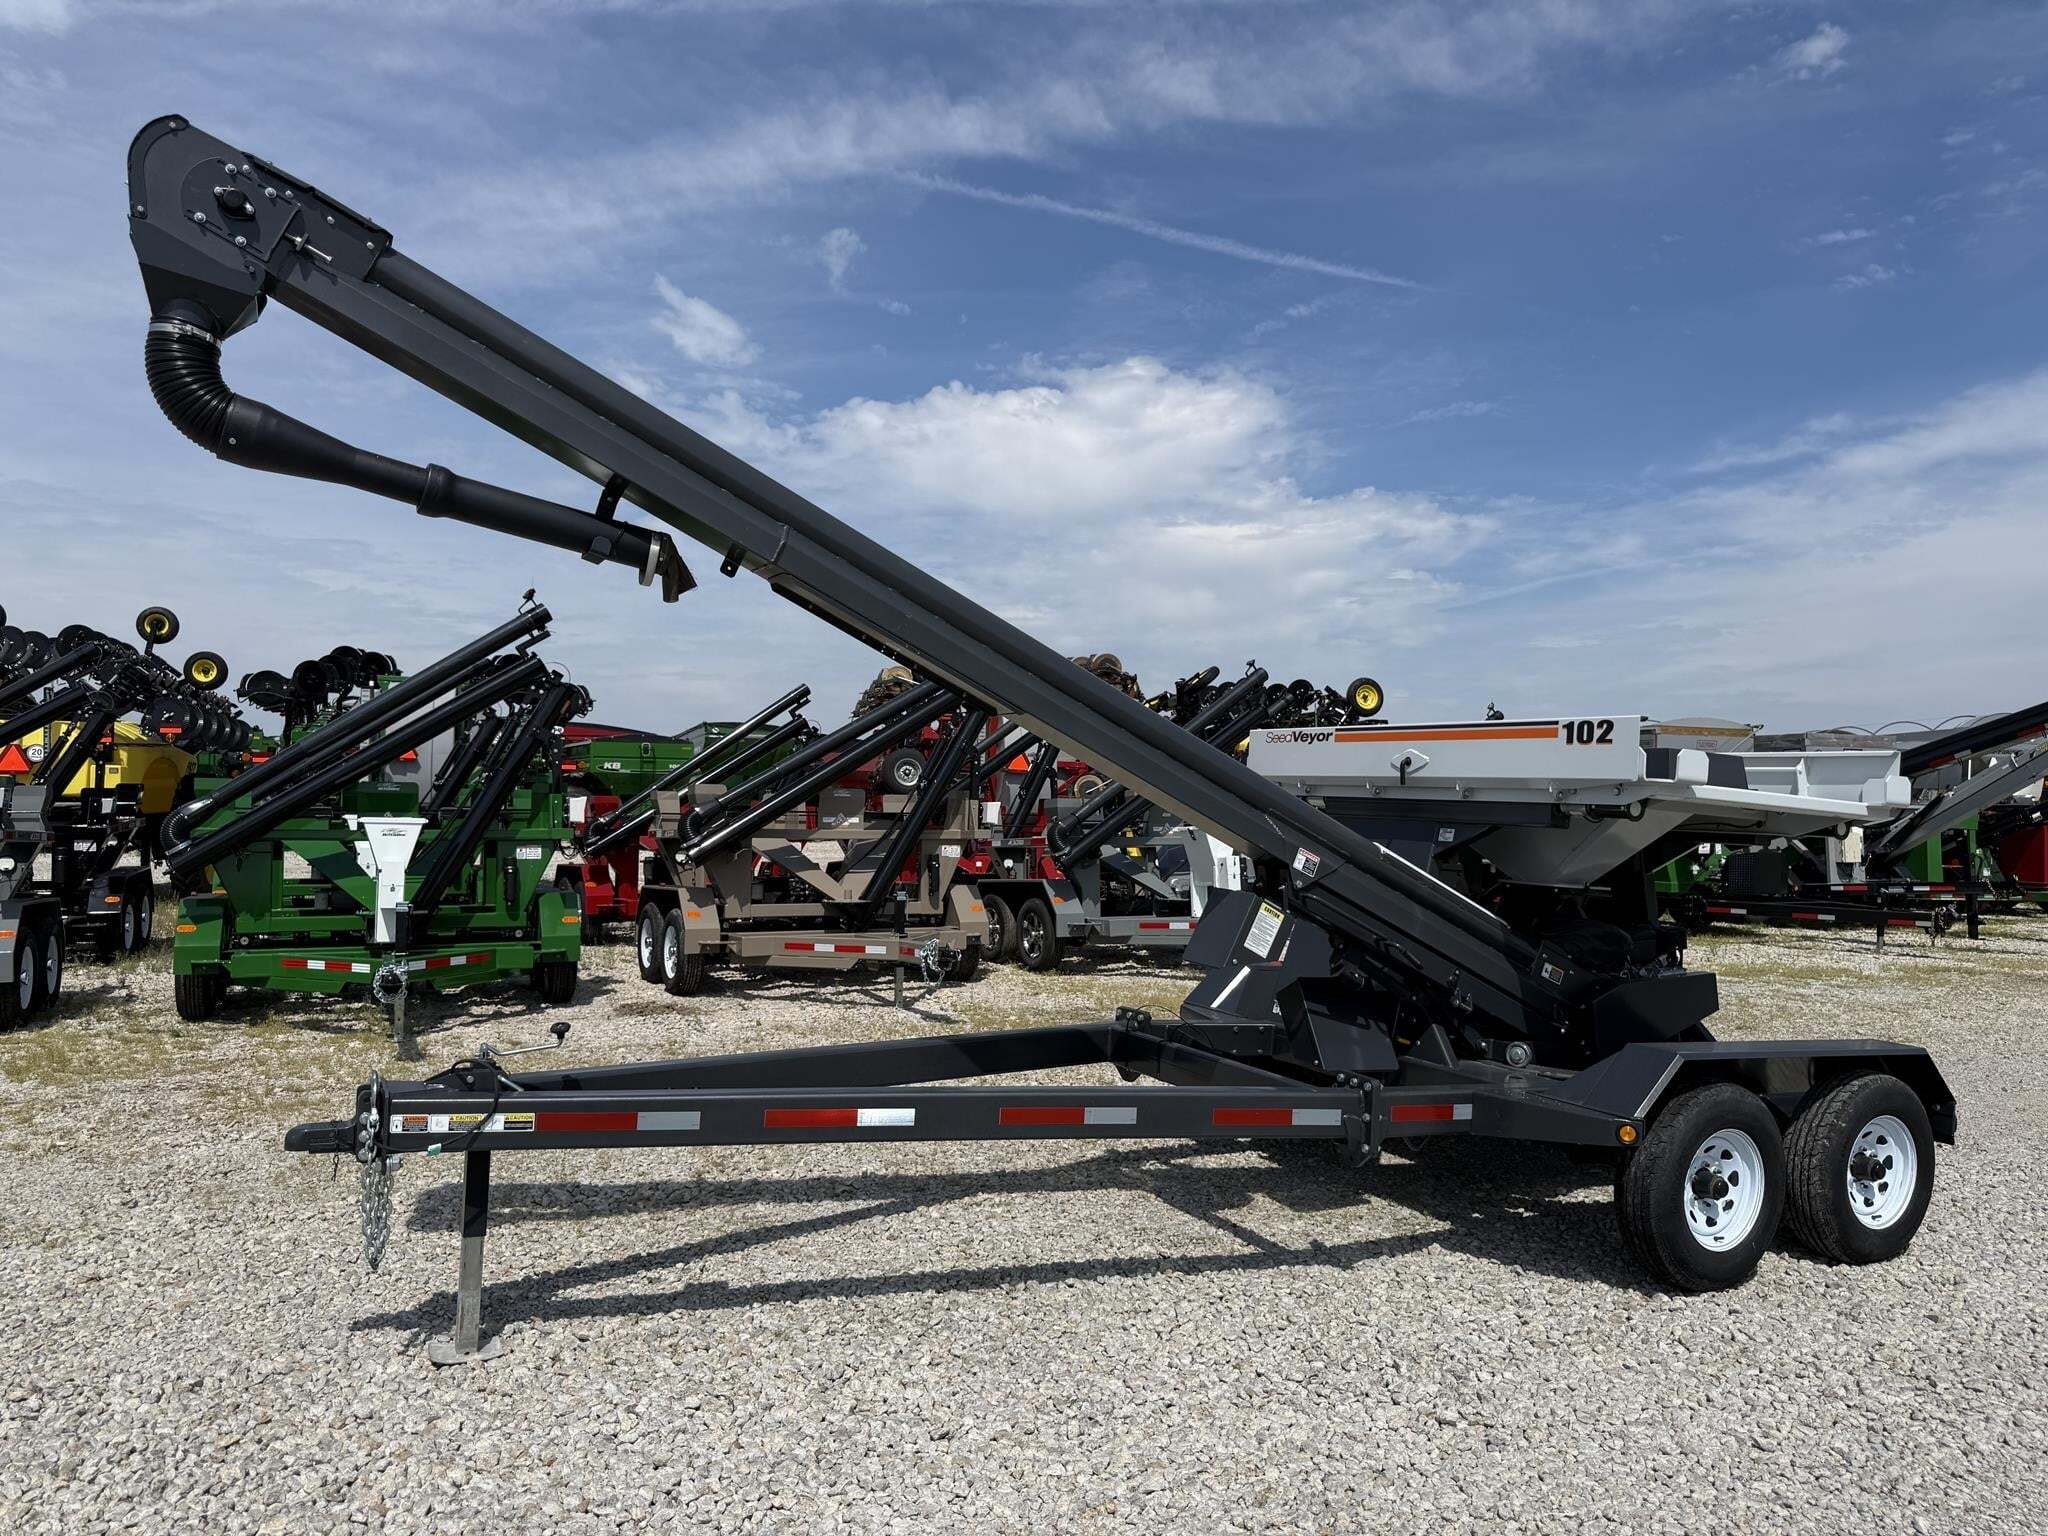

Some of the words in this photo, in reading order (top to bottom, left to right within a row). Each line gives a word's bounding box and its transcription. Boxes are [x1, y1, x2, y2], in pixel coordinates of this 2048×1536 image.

[1265, 730, 1333, 744] SeedVeyor
[1562, 719, 1615, 745] 102
[31, 748, 43, 756] 20
